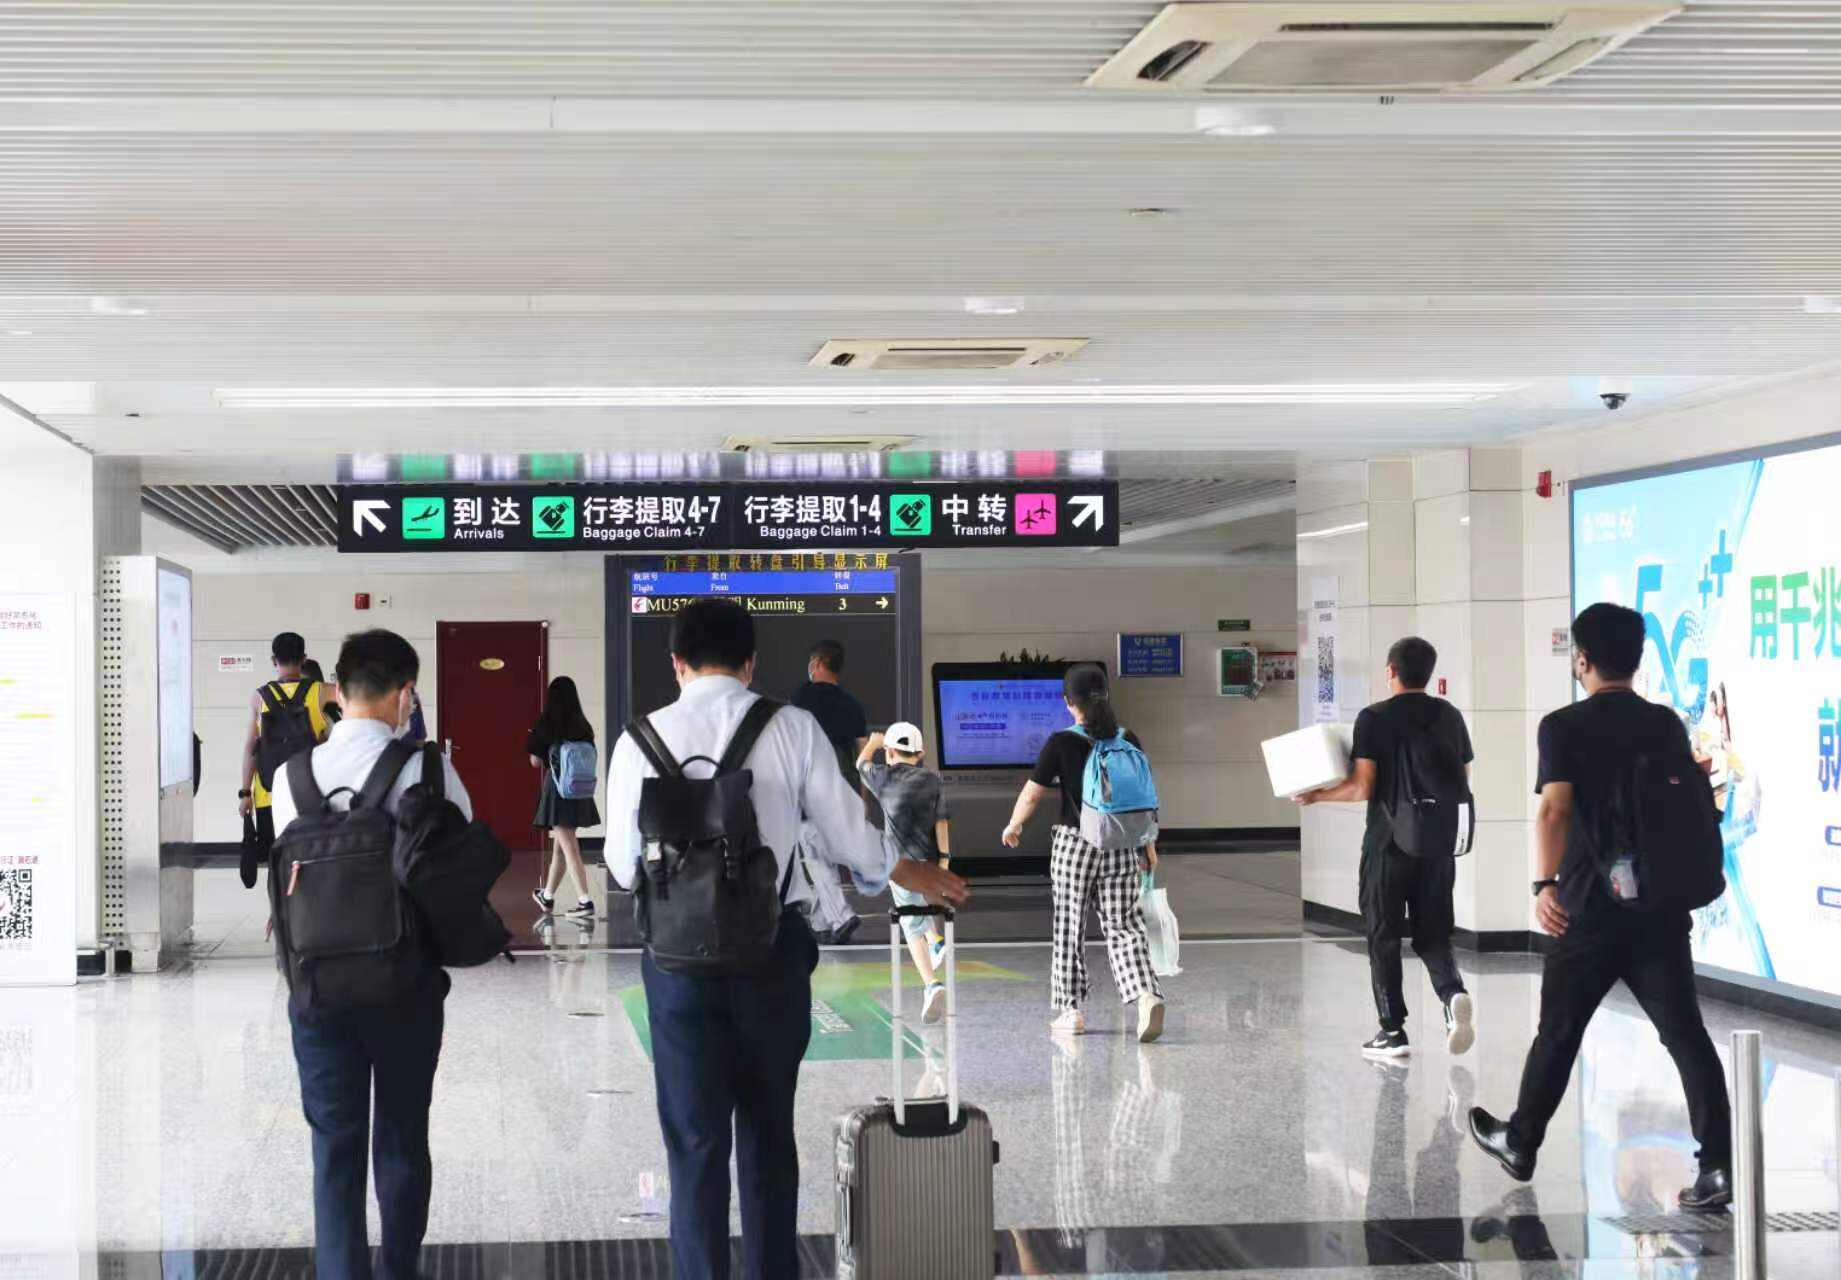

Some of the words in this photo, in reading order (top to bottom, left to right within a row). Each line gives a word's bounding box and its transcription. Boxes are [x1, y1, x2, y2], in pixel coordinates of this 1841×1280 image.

[453, 497, 520, 525] 到达
[583, 496, 720, 525] 行李提取4-7
[744, 495, 881, 524] 行李提取1-4
[942, 493, 1008, 524] 中转
[454, 527, 505, 539] Arrivals
[583, 527, 641, 541] Baggage
[644, 527, 681, 538] Claim
[684, 526, 705, 538] 4-7
[760, 525, 817, 539] Baggage
[820, 525, 858, 537] Claim
[861, 525, 882, 537] 1-4
[952, 524, 1008, 537] Transfer
[747, 598, 805, 613] Kunming
[838, 598, 847, 611] 3
